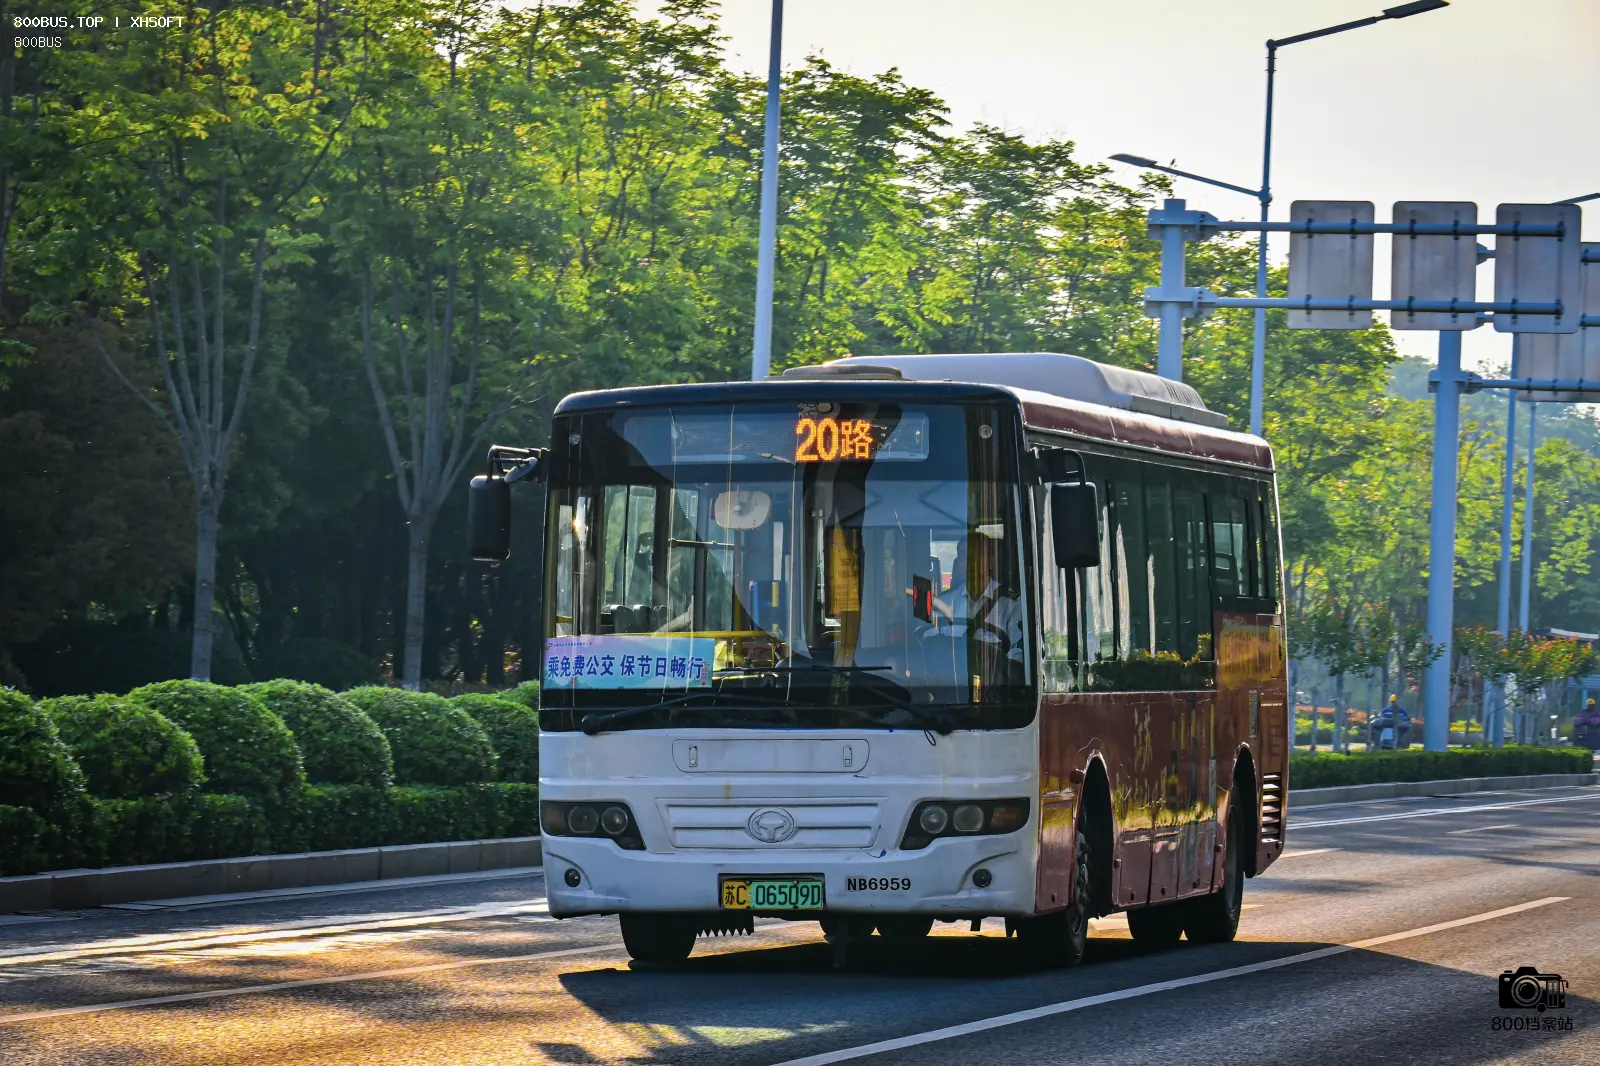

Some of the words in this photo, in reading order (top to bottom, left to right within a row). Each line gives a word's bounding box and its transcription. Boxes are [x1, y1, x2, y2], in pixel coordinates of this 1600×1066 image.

[795, 417, 873, 462] 20路
[547, 654, 616, 678] 乘免费公交
[620, 654, 704, 679] 保节日畅行
[724, 885, 747, 906] 苏C
[755, 885, 821, 906] 06509D
[847, 877, 912, 891] NB6959
